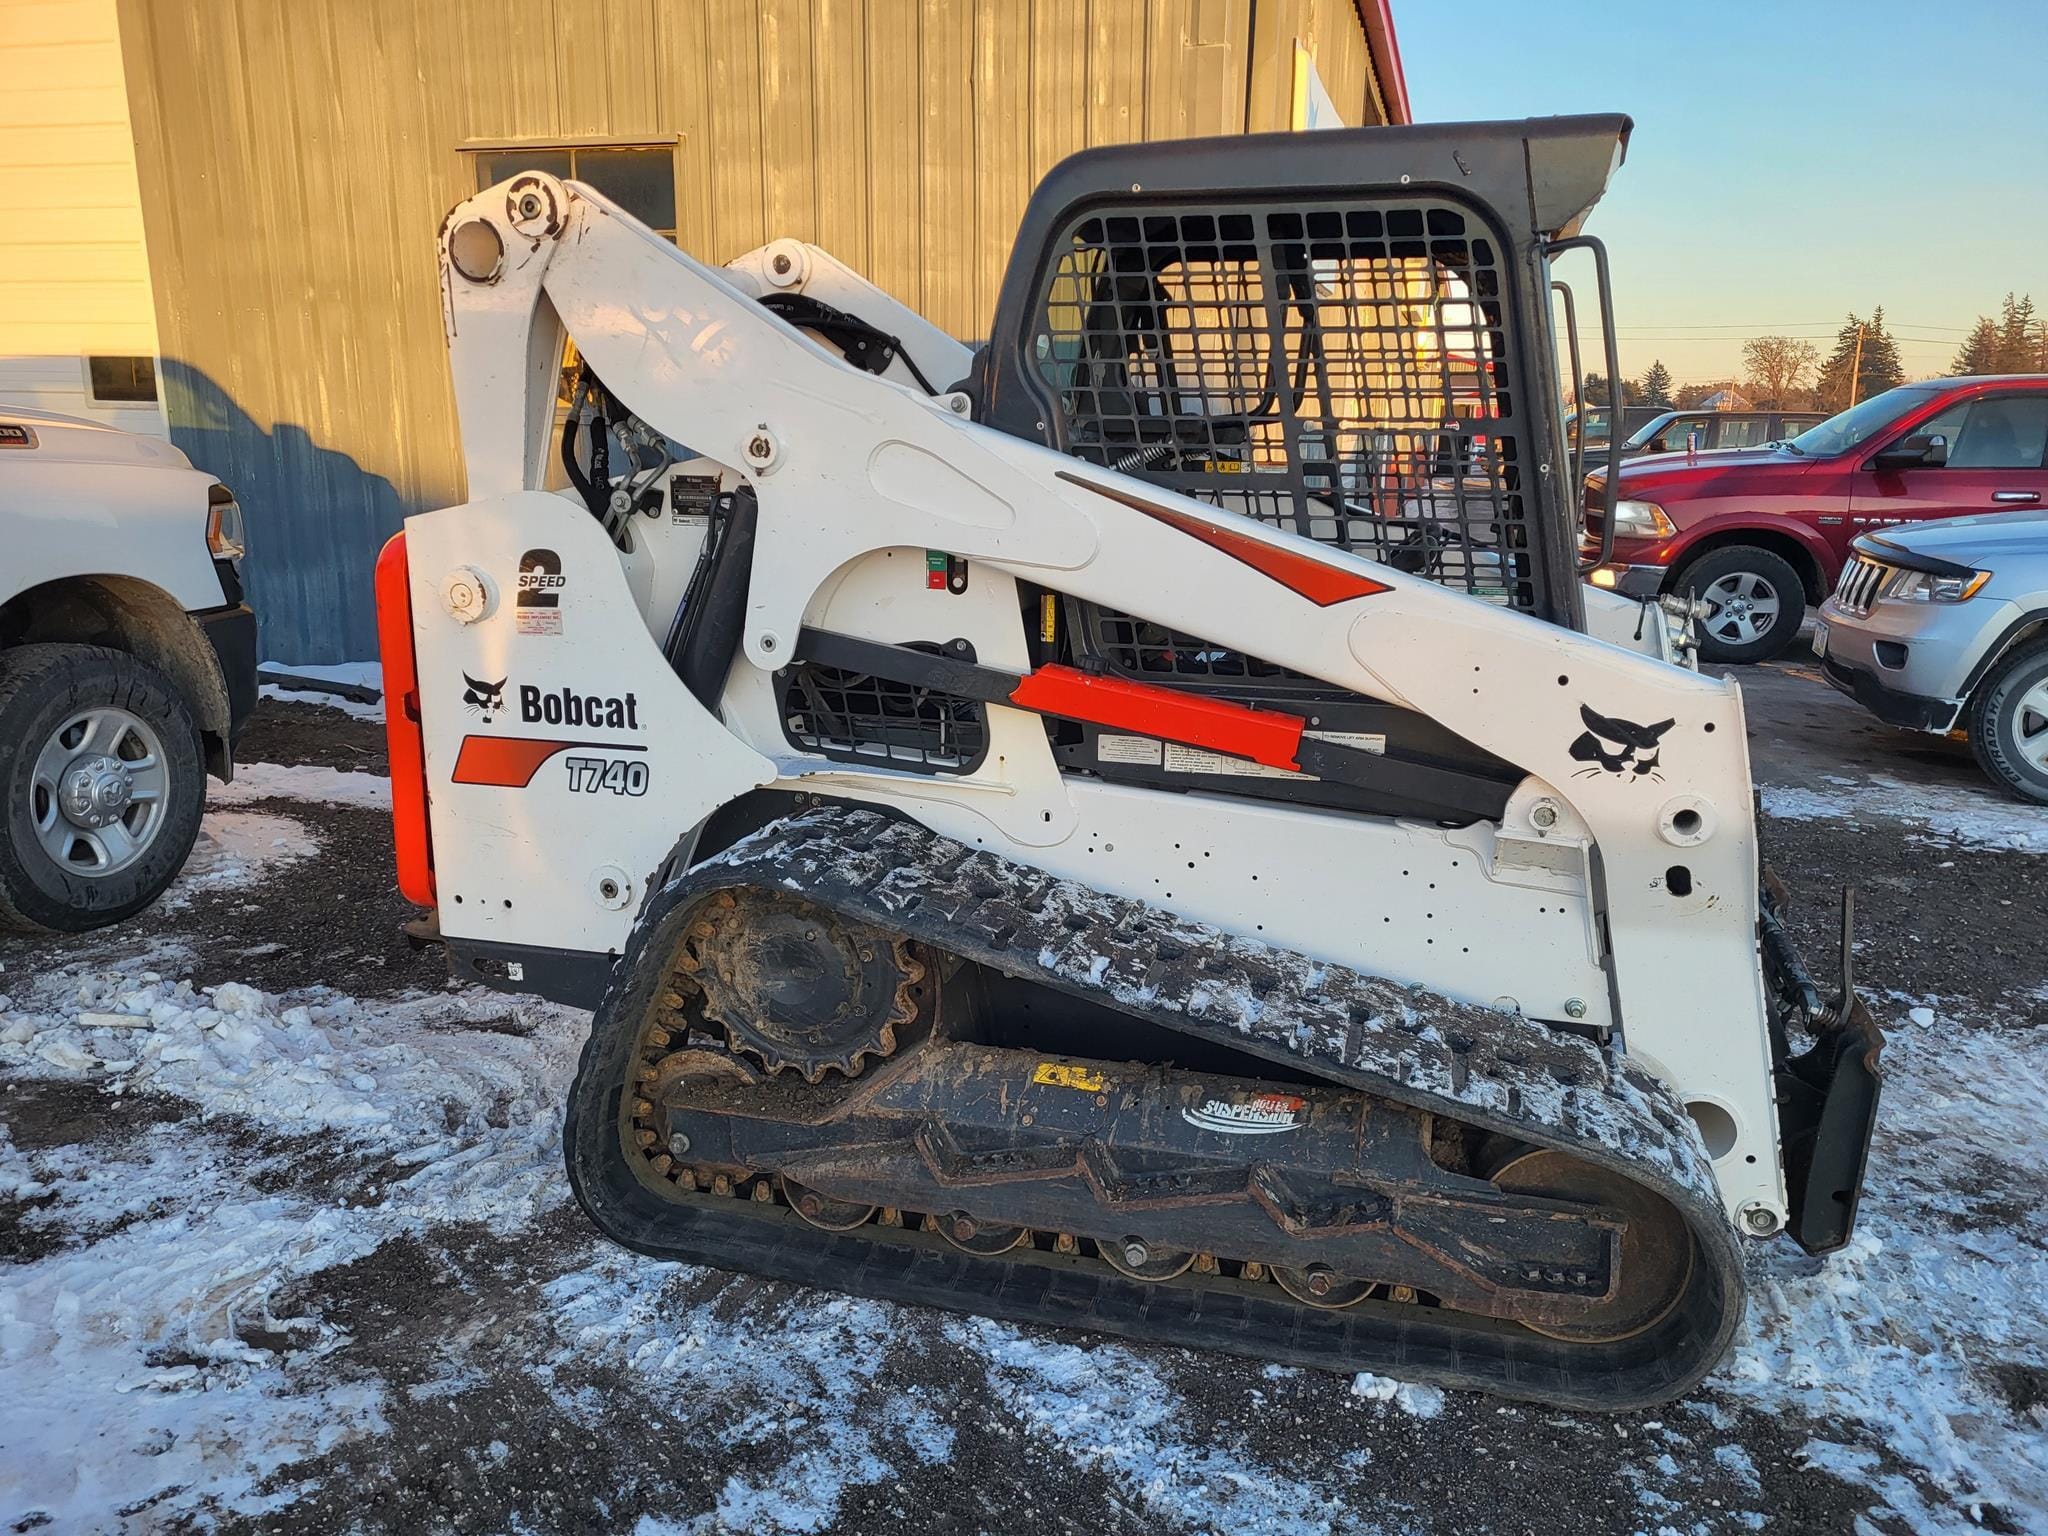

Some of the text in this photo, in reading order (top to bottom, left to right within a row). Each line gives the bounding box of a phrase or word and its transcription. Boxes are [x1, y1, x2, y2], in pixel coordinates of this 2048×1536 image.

[516, 548, 562, 608] 2
[517, 575, 567, 588] SPEED
[519, 684, 639, 731] Bobcat
[1986, 717, 2023, 783] ENTRADA
[565, 757, 649, 796] T740
